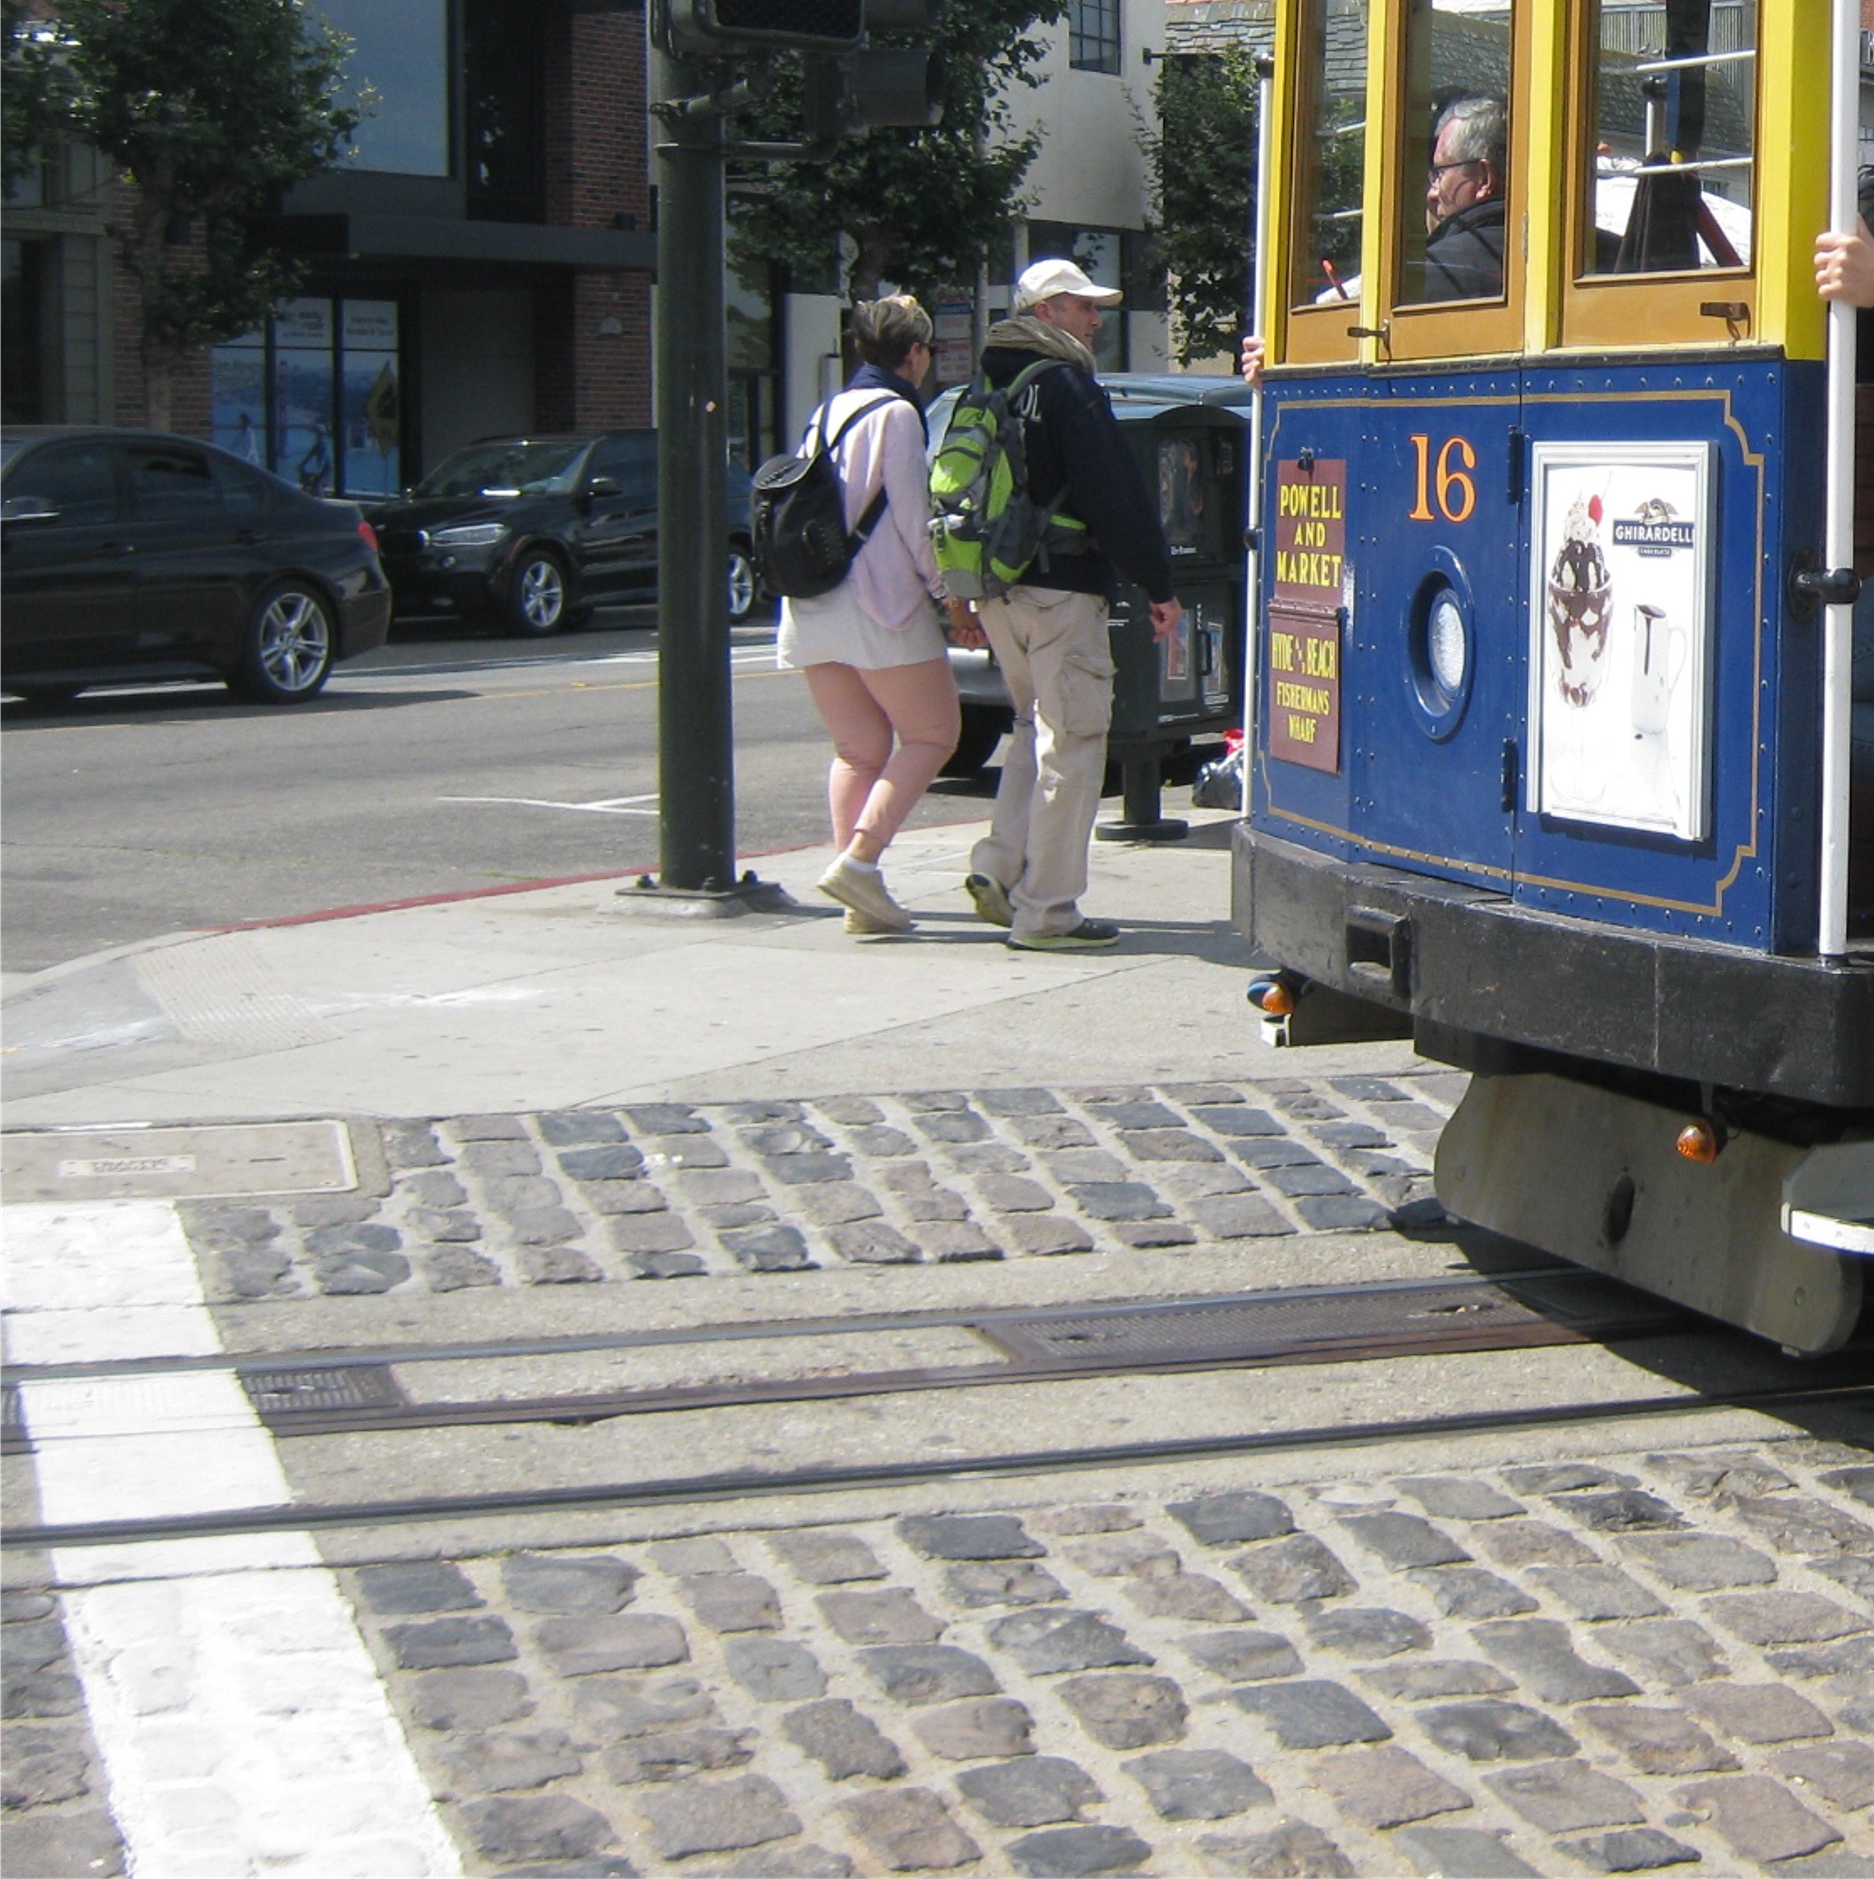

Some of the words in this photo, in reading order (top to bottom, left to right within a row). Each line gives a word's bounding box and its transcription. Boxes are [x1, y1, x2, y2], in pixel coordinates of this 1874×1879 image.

[1409, 433, 1477, 523] 16
[1280, 484, 1342, 519] POWELL
[1294, 522, 1326, 547] AND
[1276, 550, 1342, 588] MARKET
[1272, 632, 1294, 672] HYDE
[1307, 637, 1336, 679] BEACH
[1277, 681, 1331, 716] FISHERMANS
[1288, 714, 1317, 743] WHARF
